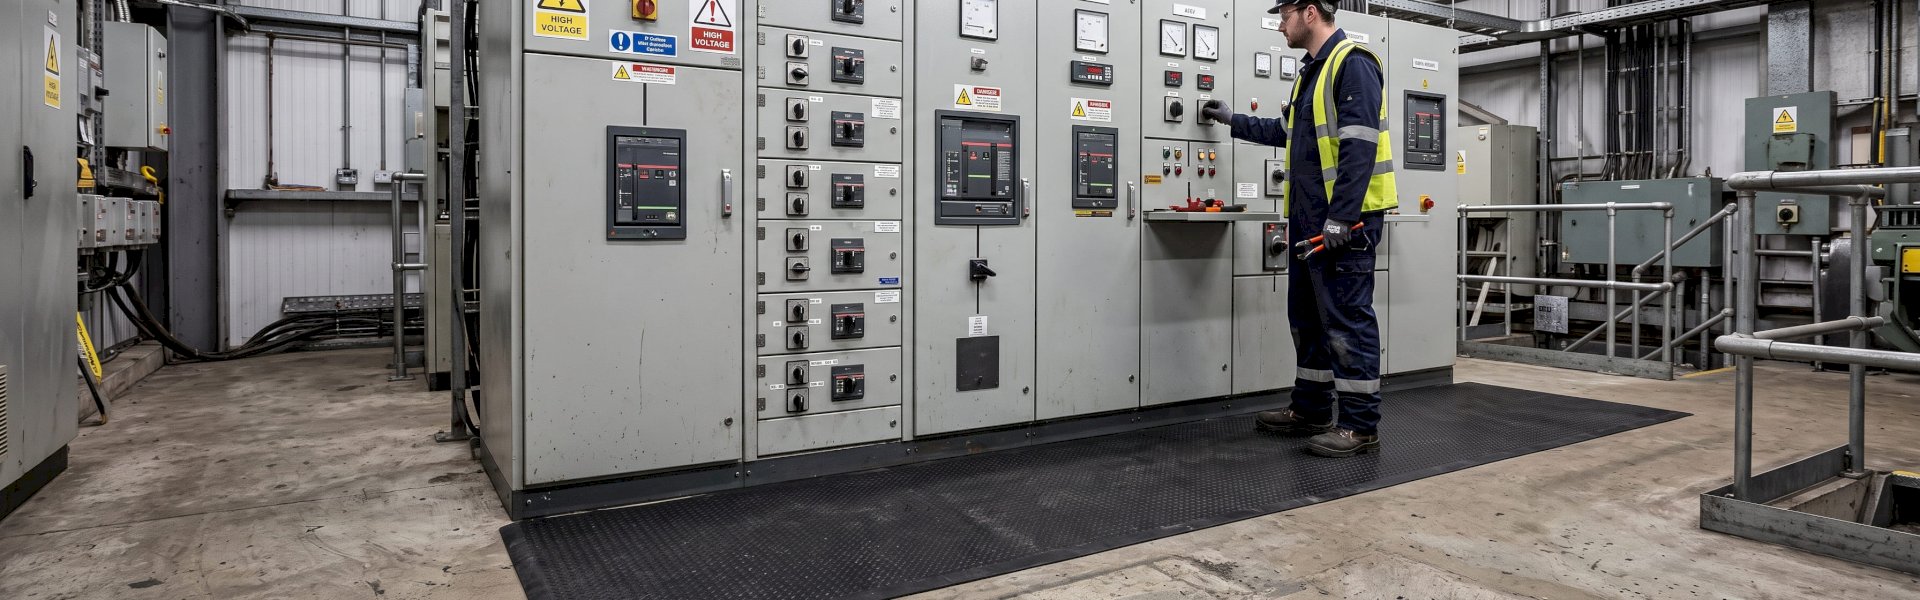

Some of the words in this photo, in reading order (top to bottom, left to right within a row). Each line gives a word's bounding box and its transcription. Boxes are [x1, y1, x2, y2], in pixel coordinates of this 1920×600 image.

[551, 15, 572, 24] HIGH
[541, 24, 582, 35] VOLTAGE
[703, 30, 722, 40] HIGH
[694, 38, 730, 49] VOLTAGE
